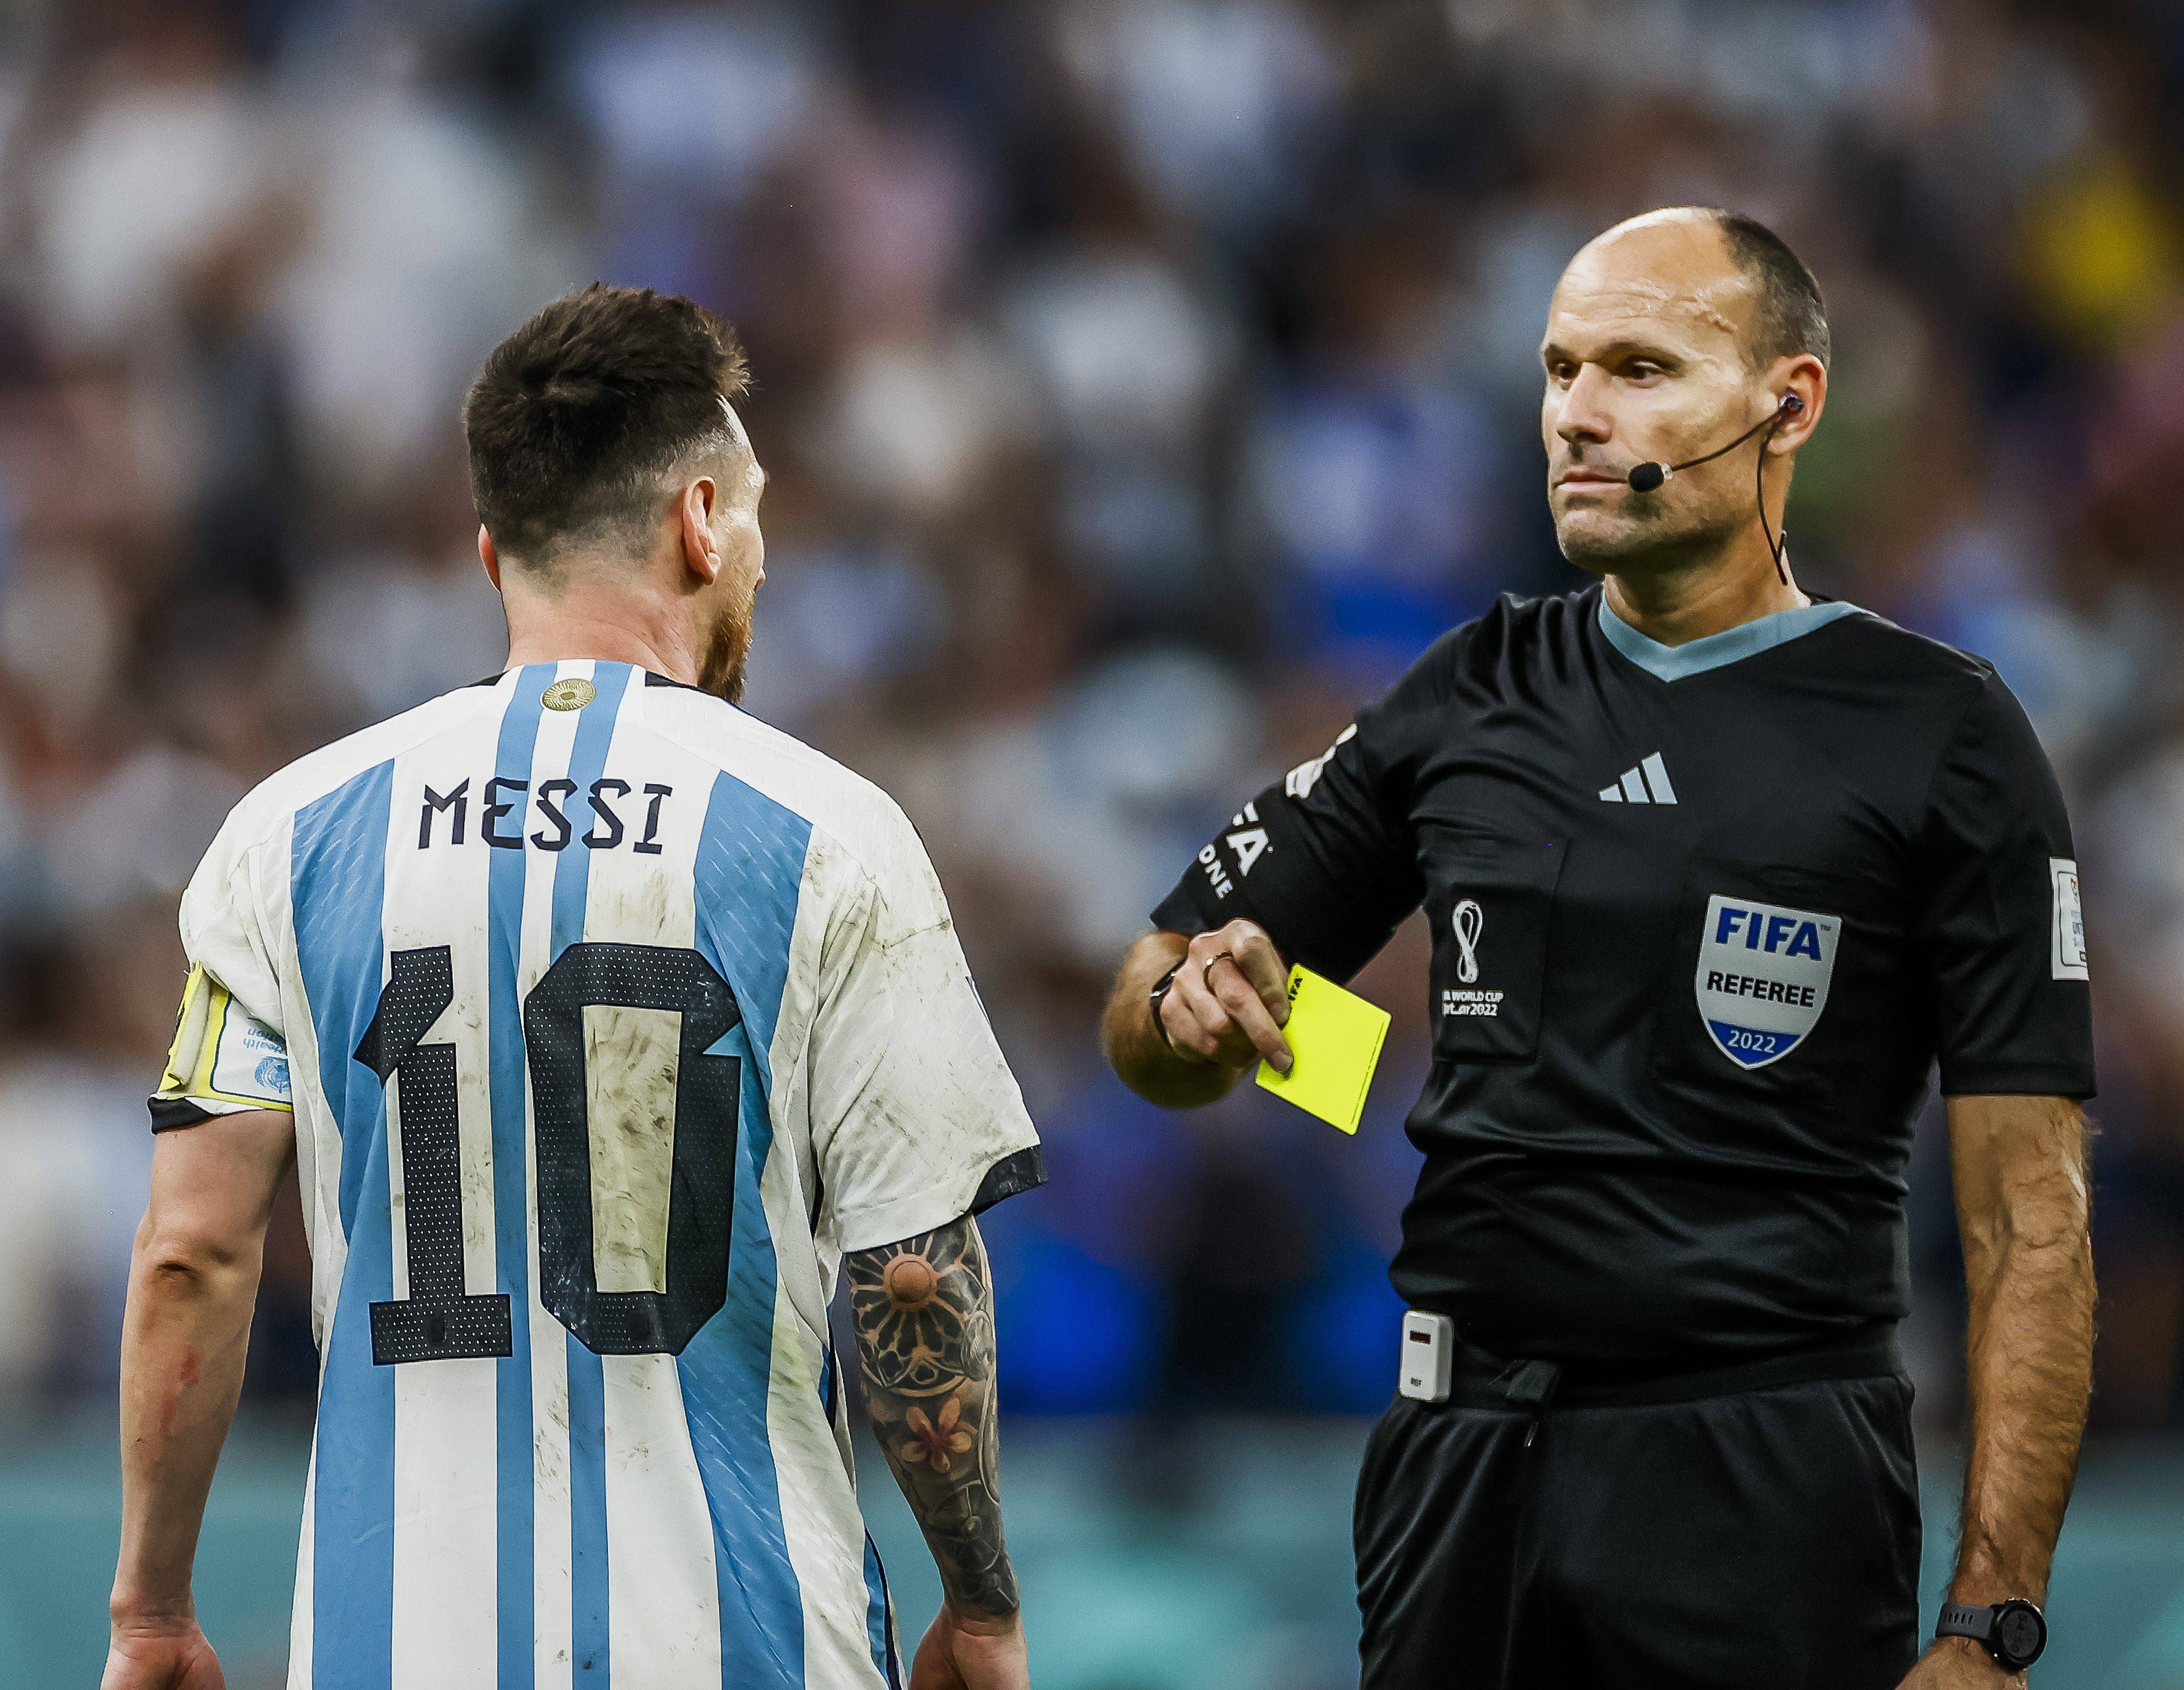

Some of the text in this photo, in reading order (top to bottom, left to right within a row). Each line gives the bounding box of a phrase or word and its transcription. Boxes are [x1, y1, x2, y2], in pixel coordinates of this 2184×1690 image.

[418, 777, 673, 855] MESSI
[1715, 906, 1822, 962] FIFA
[1452, 990, 1485, 1002] WORLD
[1485, 991, 1504, 1003] CUP
[1706, 970, 1817, 1008] REFEREE
[1727, 1029, 1778, 1054] 2022
[352, 942, 742, 1366] 10
